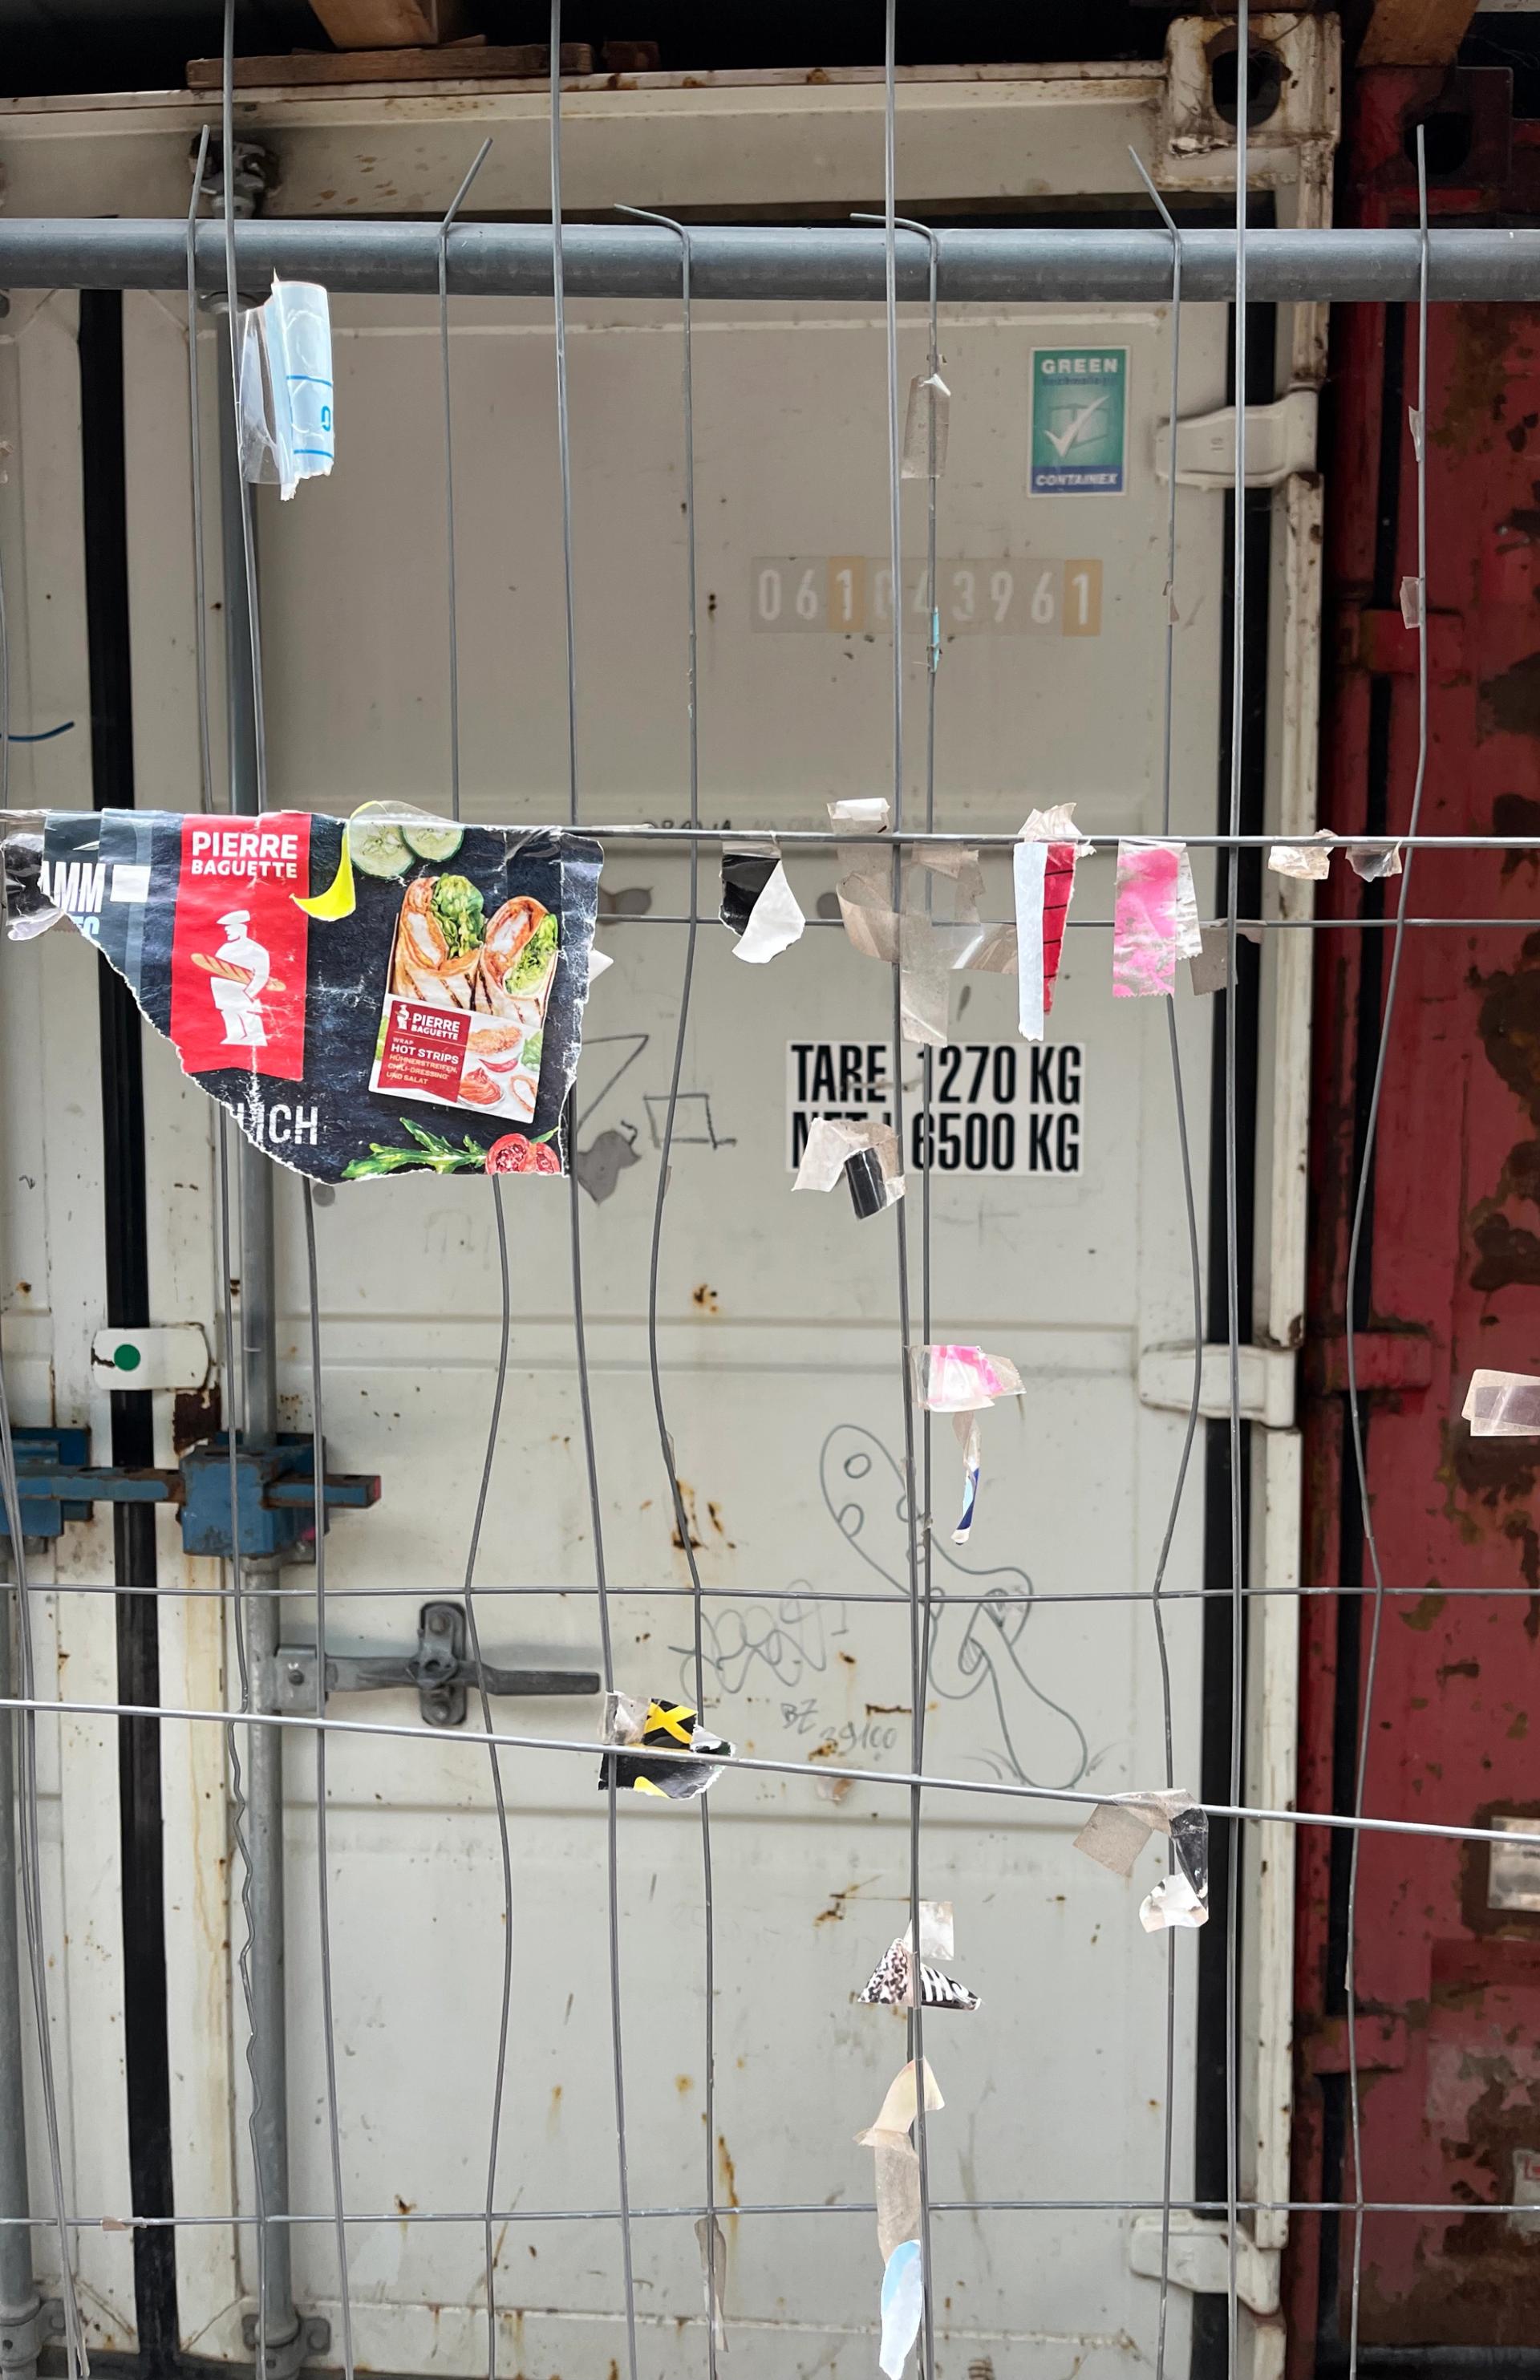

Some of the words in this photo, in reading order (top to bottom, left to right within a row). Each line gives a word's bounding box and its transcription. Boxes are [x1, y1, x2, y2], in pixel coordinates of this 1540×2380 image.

[1042, 358, 1118, 375] GREEN
[1035, 473, 1119, 486] CONTAINEX
[192, 831, 298, 859] PIERRE
[191, 859, 298, 879] BAGUETTE
[411, 1024, 459, 1040] BAGUETTE
[412, 1012, 460, 1033] PIERRE
[392, 1036, 414, 1045] WRAP
[391, 1043, 416, 1056] HOT
[418, 1048, 460, 1064] STRIPS
[386, 1071, 403, 1080] UND
[403, 1074, 429, 1085] SALAT
[791, 1044, 886, 1103] TARE
[917, 1044, 1015, 1105] 1270
[1030, 1045, 1081, 1105] KG
[1029, 1113, 1080, 1172] KG
